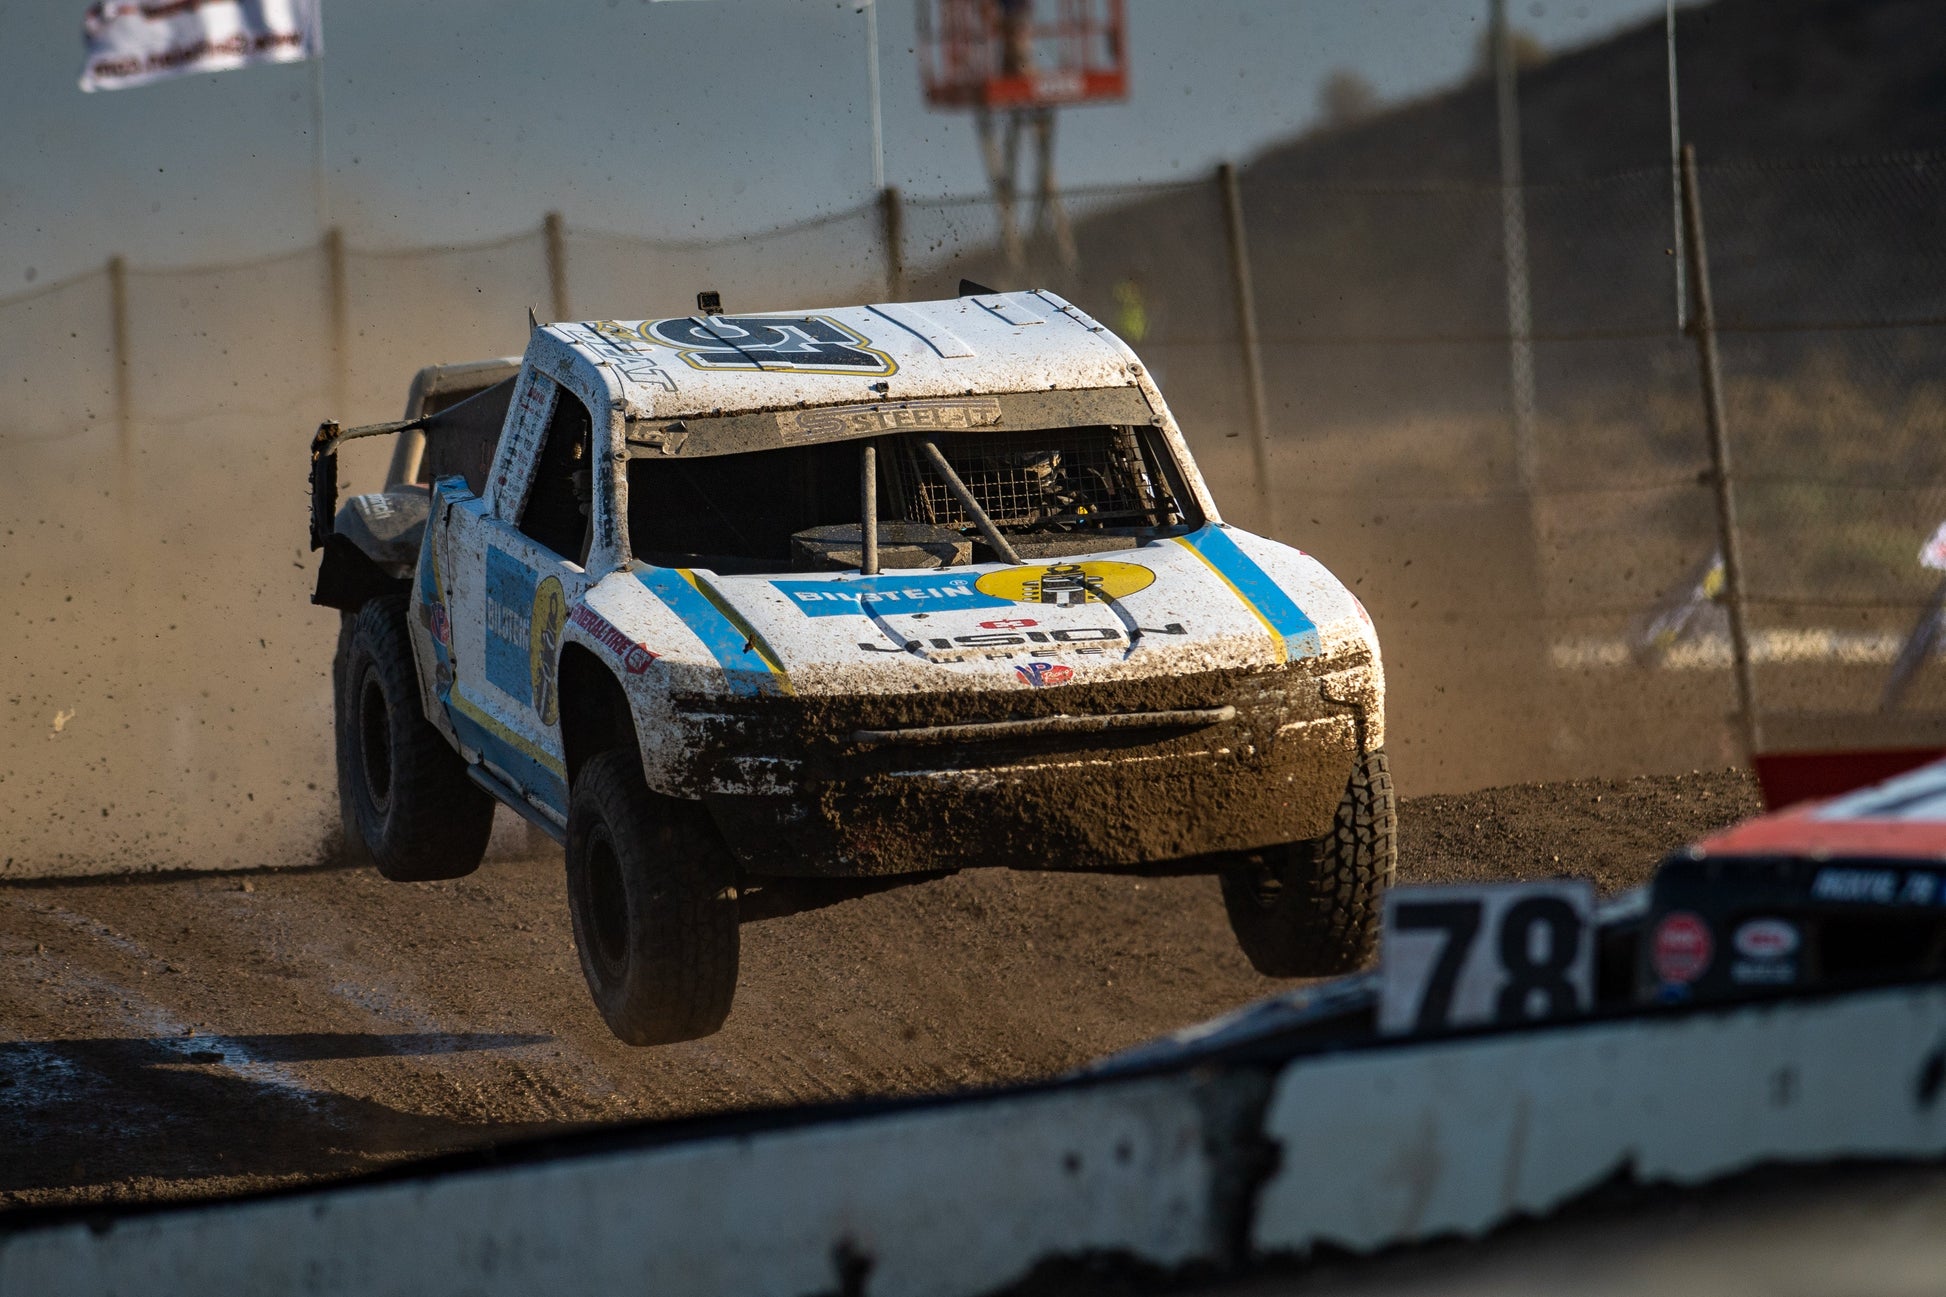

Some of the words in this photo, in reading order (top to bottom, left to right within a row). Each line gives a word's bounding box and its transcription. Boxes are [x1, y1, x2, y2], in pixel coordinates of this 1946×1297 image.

[851, 406, 993, 433] STEEL-IT
[793, 584, 975, 602] BILSTEIN
[601, 626, 636, 656] TIRE
[858, 622, 1188, 653] VISION
[1014, 662, 1052, 687] VP
[1395, 898, 1584, 1036] 78
